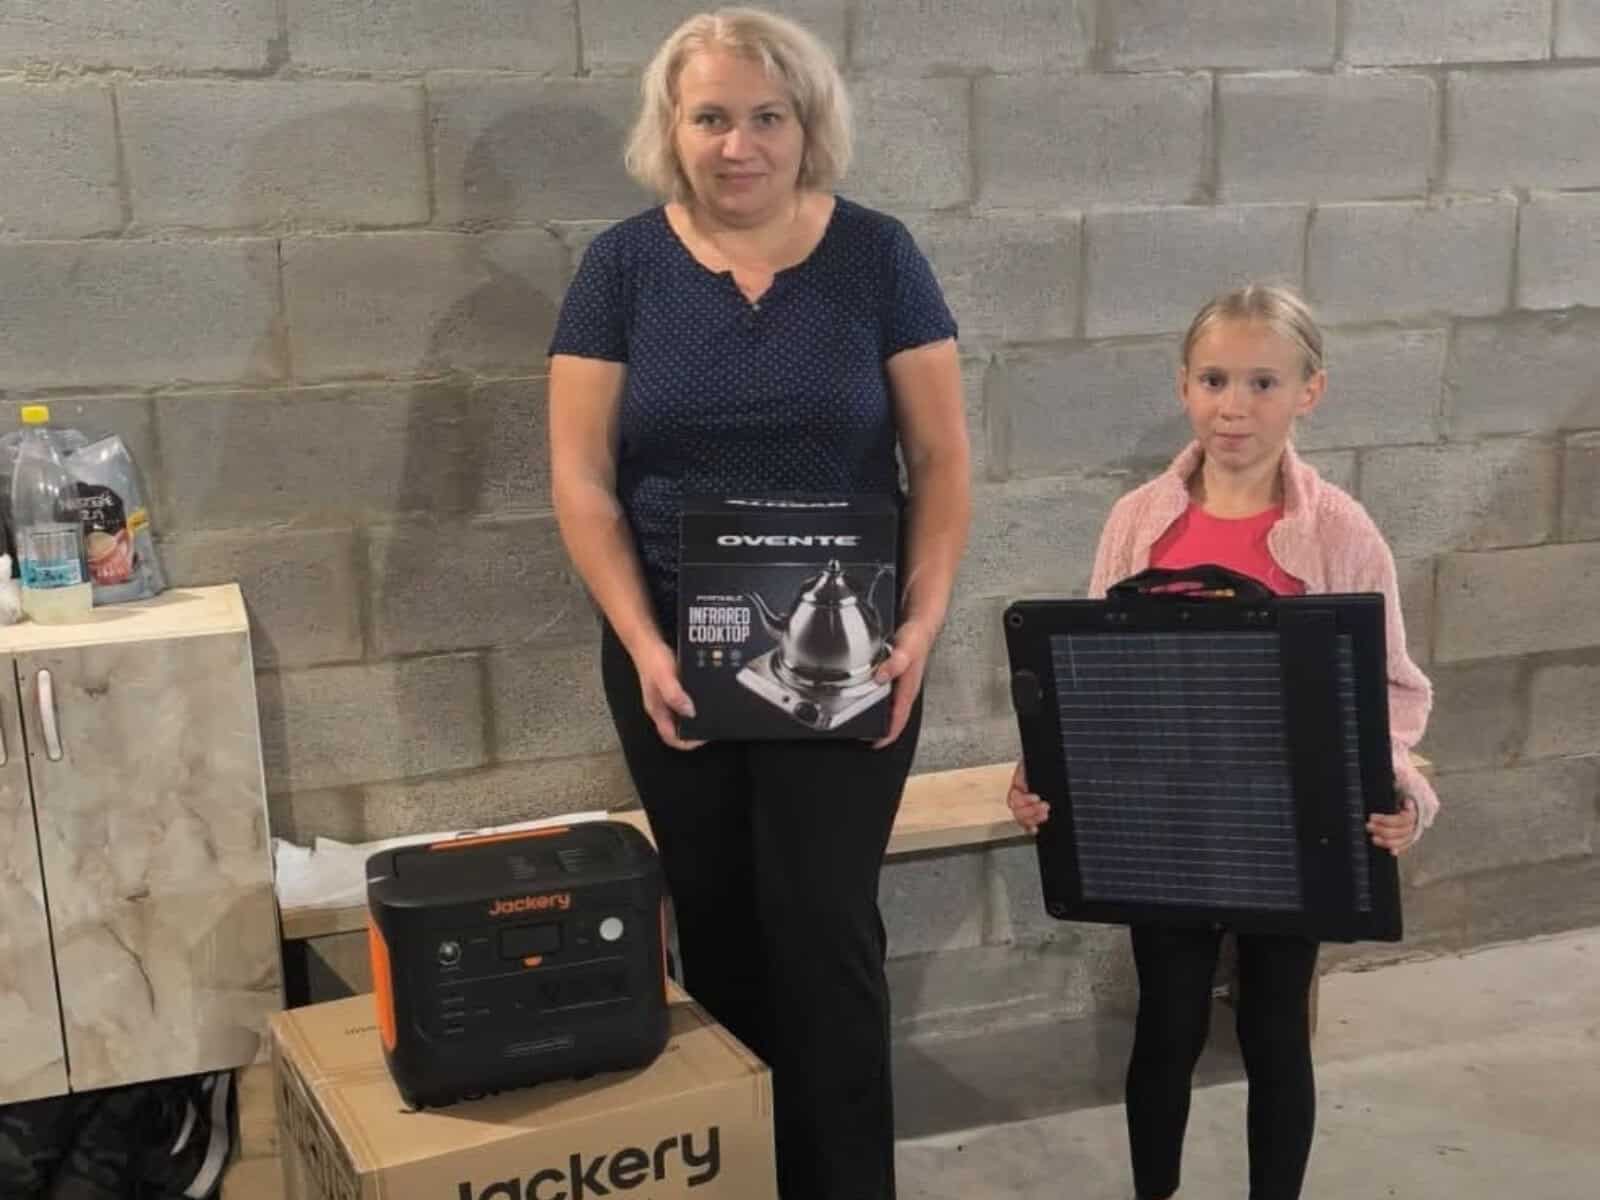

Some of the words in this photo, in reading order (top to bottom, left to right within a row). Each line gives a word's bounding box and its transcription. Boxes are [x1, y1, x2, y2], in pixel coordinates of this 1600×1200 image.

[716, 535, 861, 546] OVENTE
[689, 606, 750, 624] INFRARED
[688, 625, 750, 642] COOKTOP
[488, 893, 571, 916] Jackery
